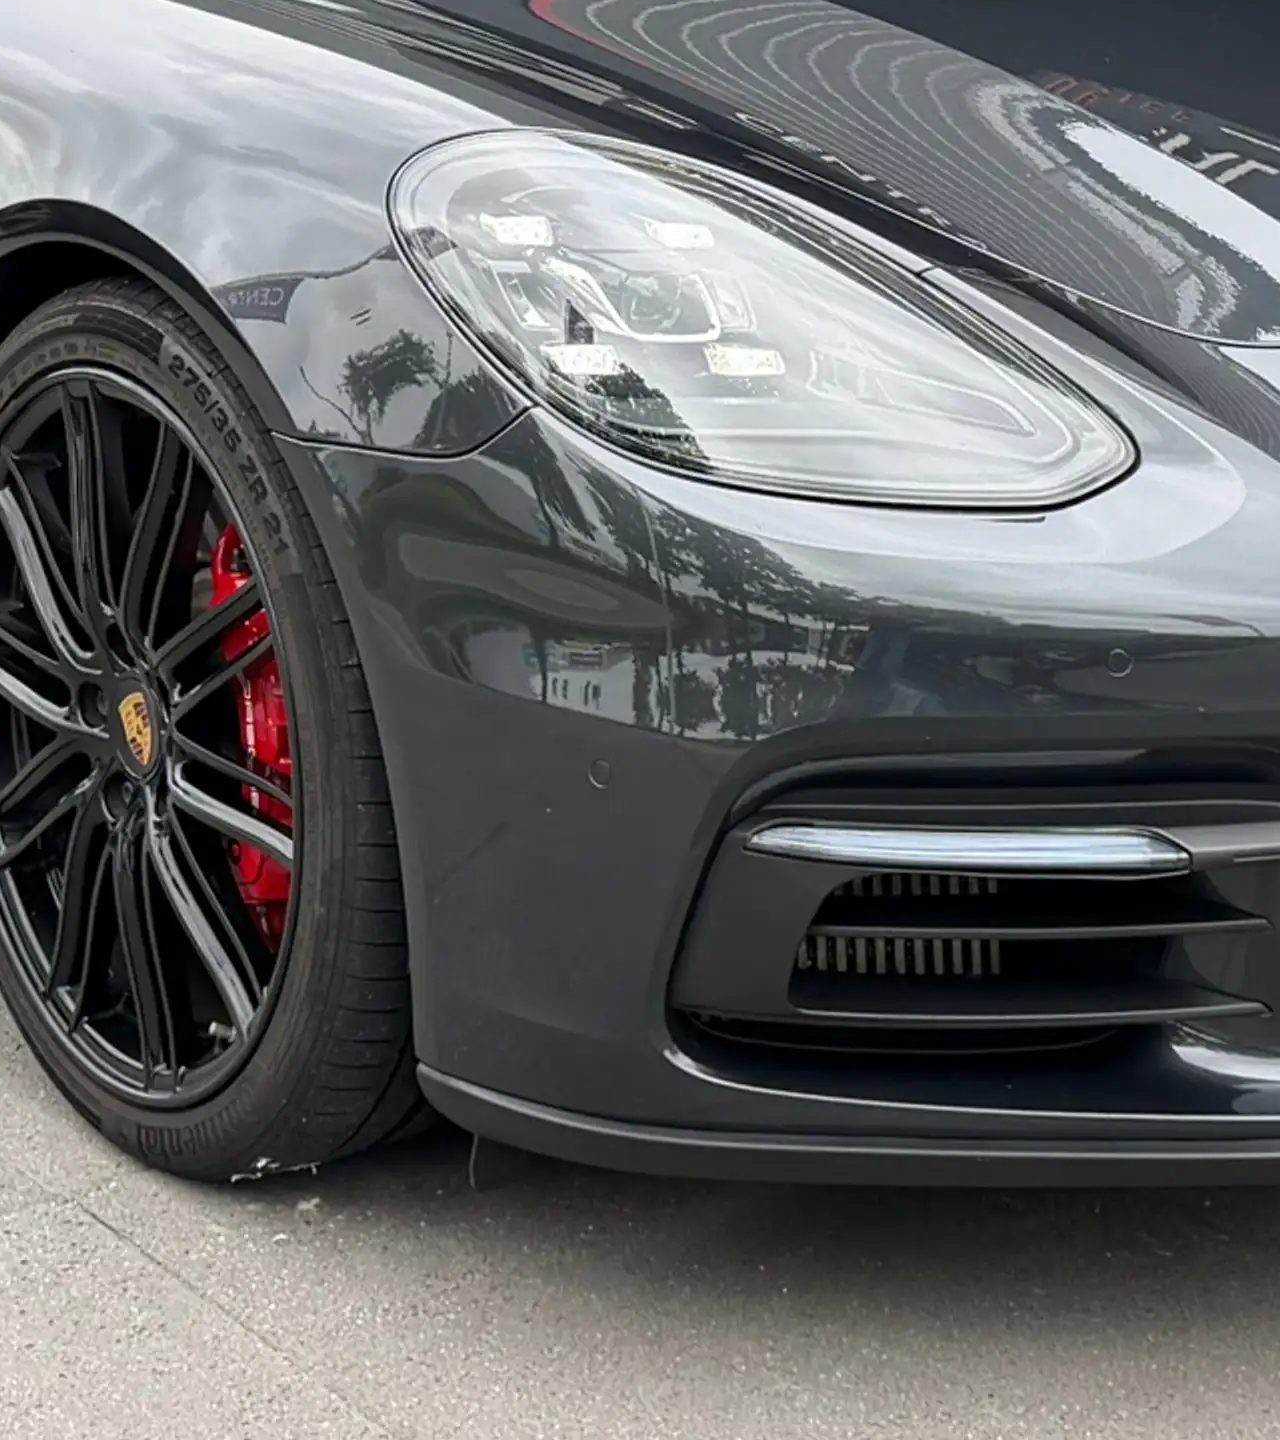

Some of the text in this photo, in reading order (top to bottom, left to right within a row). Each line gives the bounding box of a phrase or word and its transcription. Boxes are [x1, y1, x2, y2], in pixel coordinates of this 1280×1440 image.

[168, 354, 290, 557] 275/35 ZR 21
